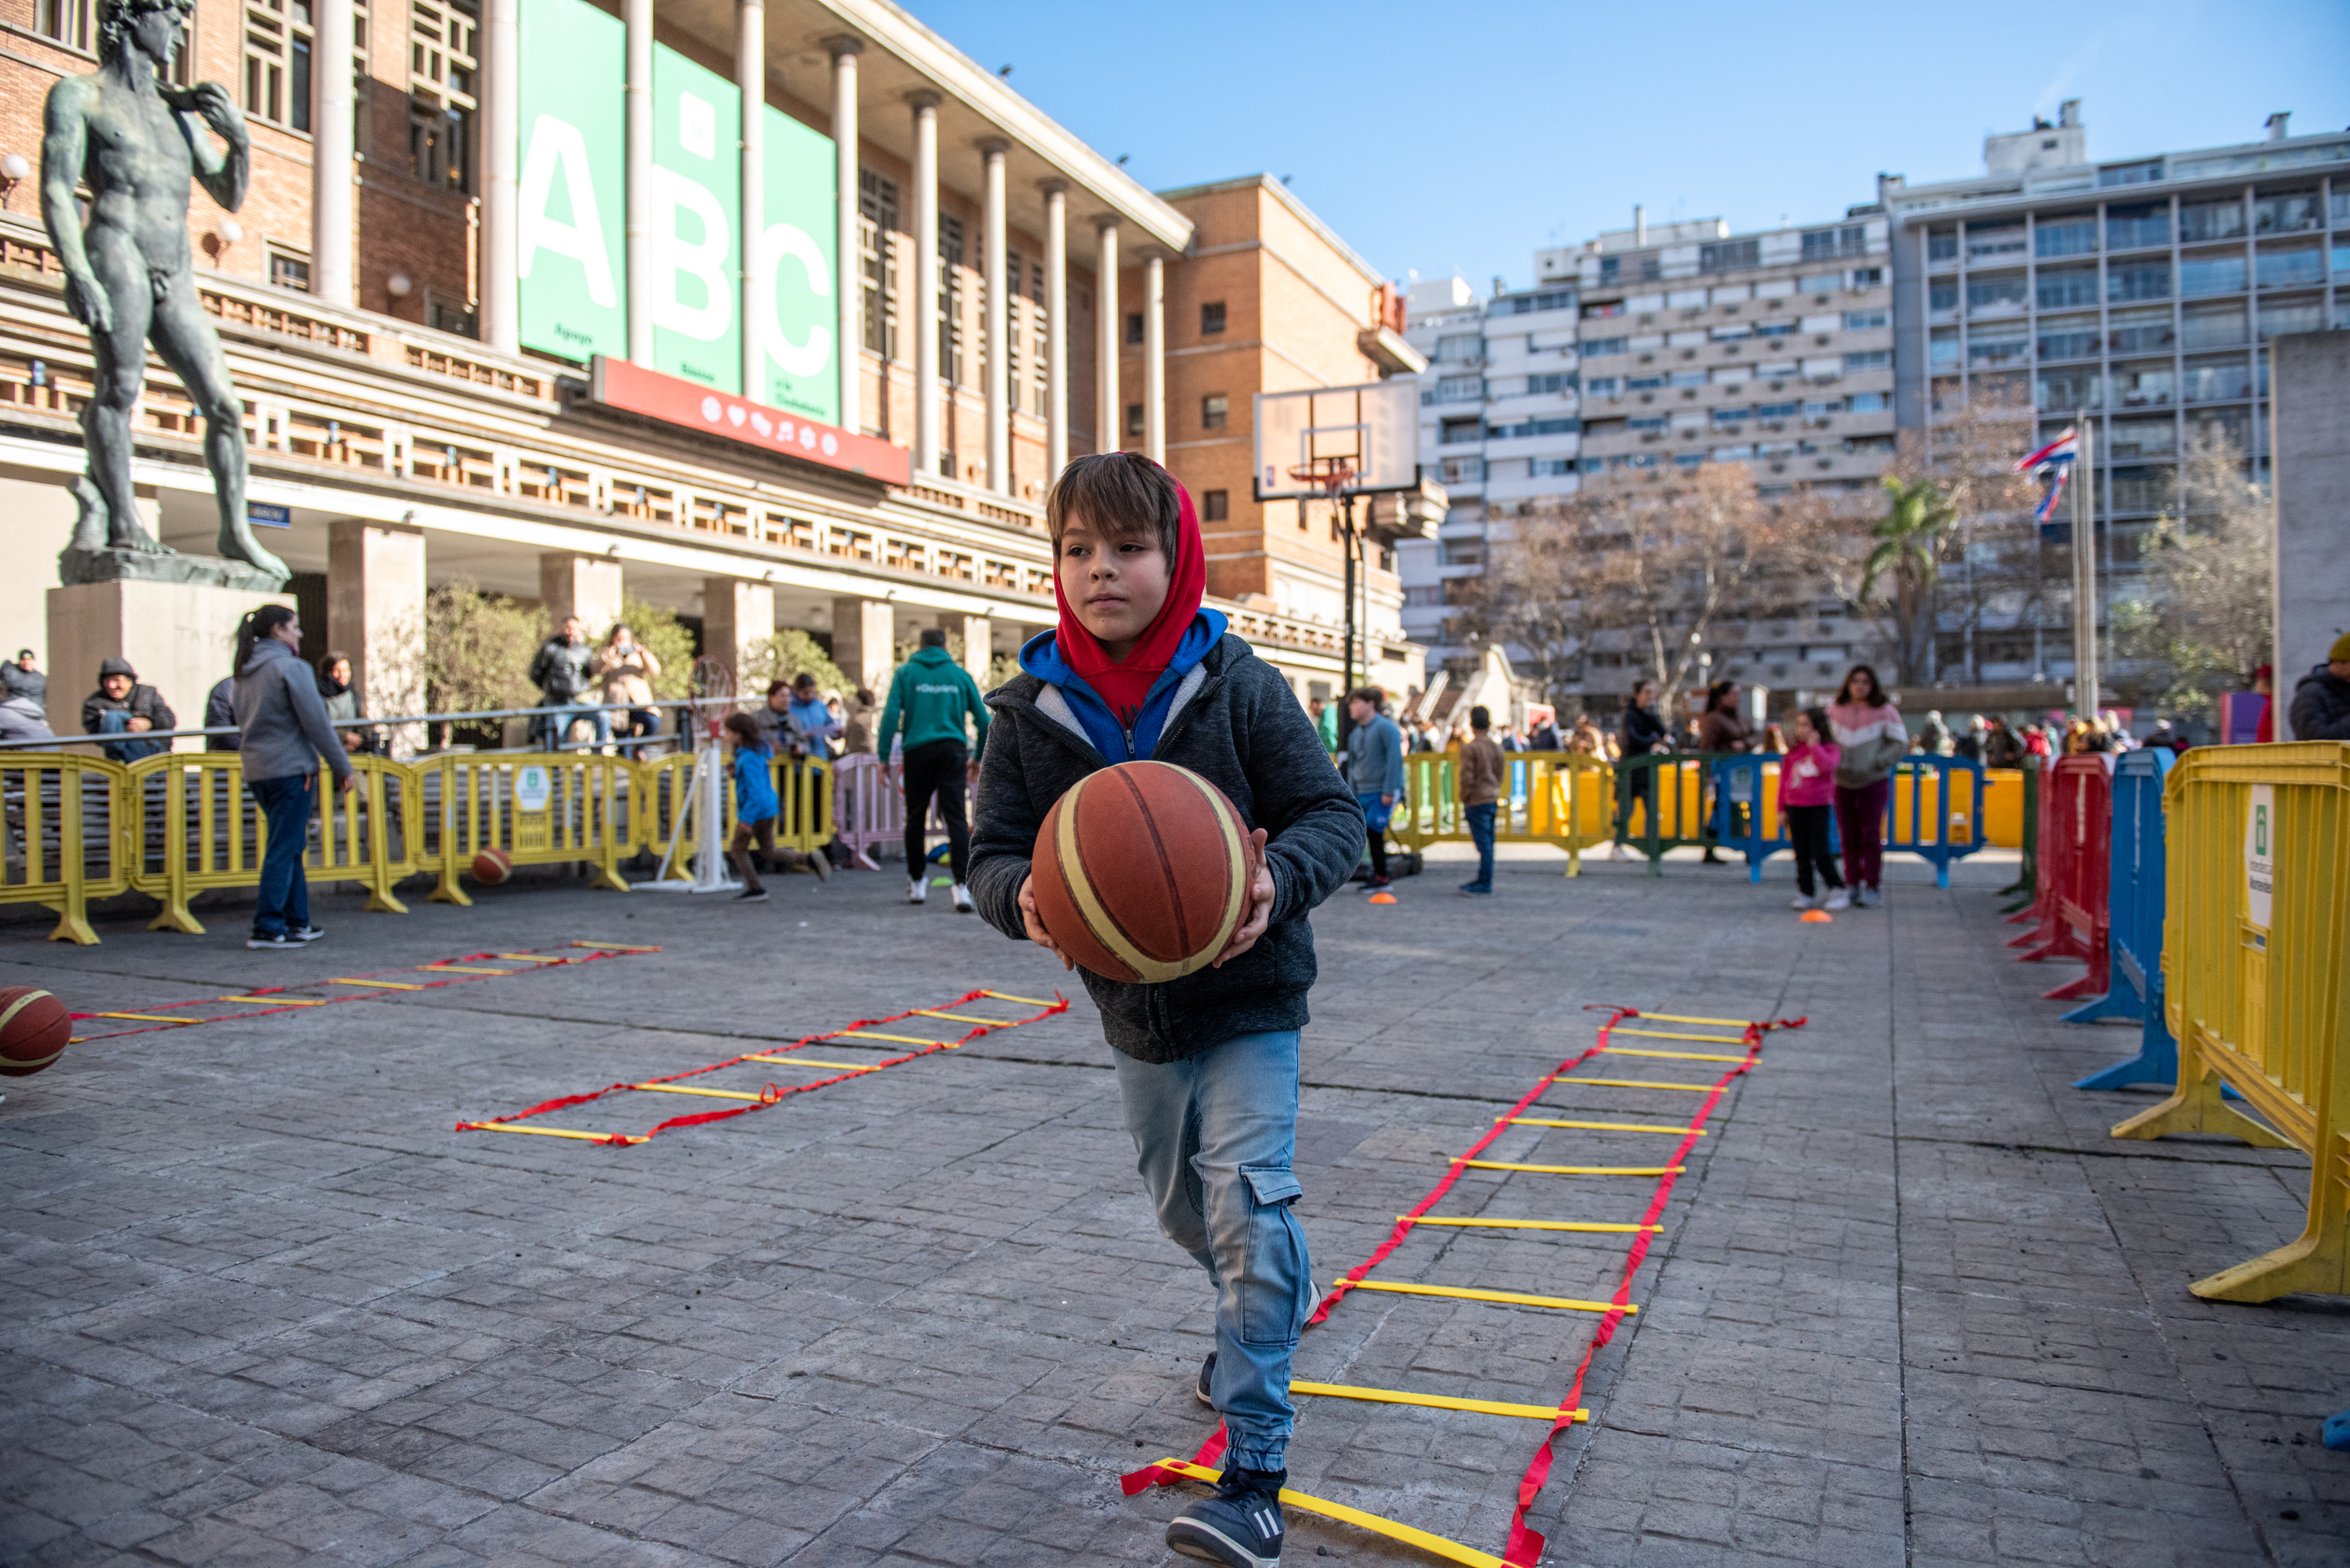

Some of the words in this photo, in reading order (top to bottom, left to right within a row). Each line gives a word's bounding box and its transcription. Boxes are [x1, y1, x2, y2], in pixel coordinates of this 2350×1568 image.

[519, 113, 617, 309] A
[652, 163, 732, 341] B
[763, 222, 832, 377] C
[554, 322, 593, 345] Apoyo
